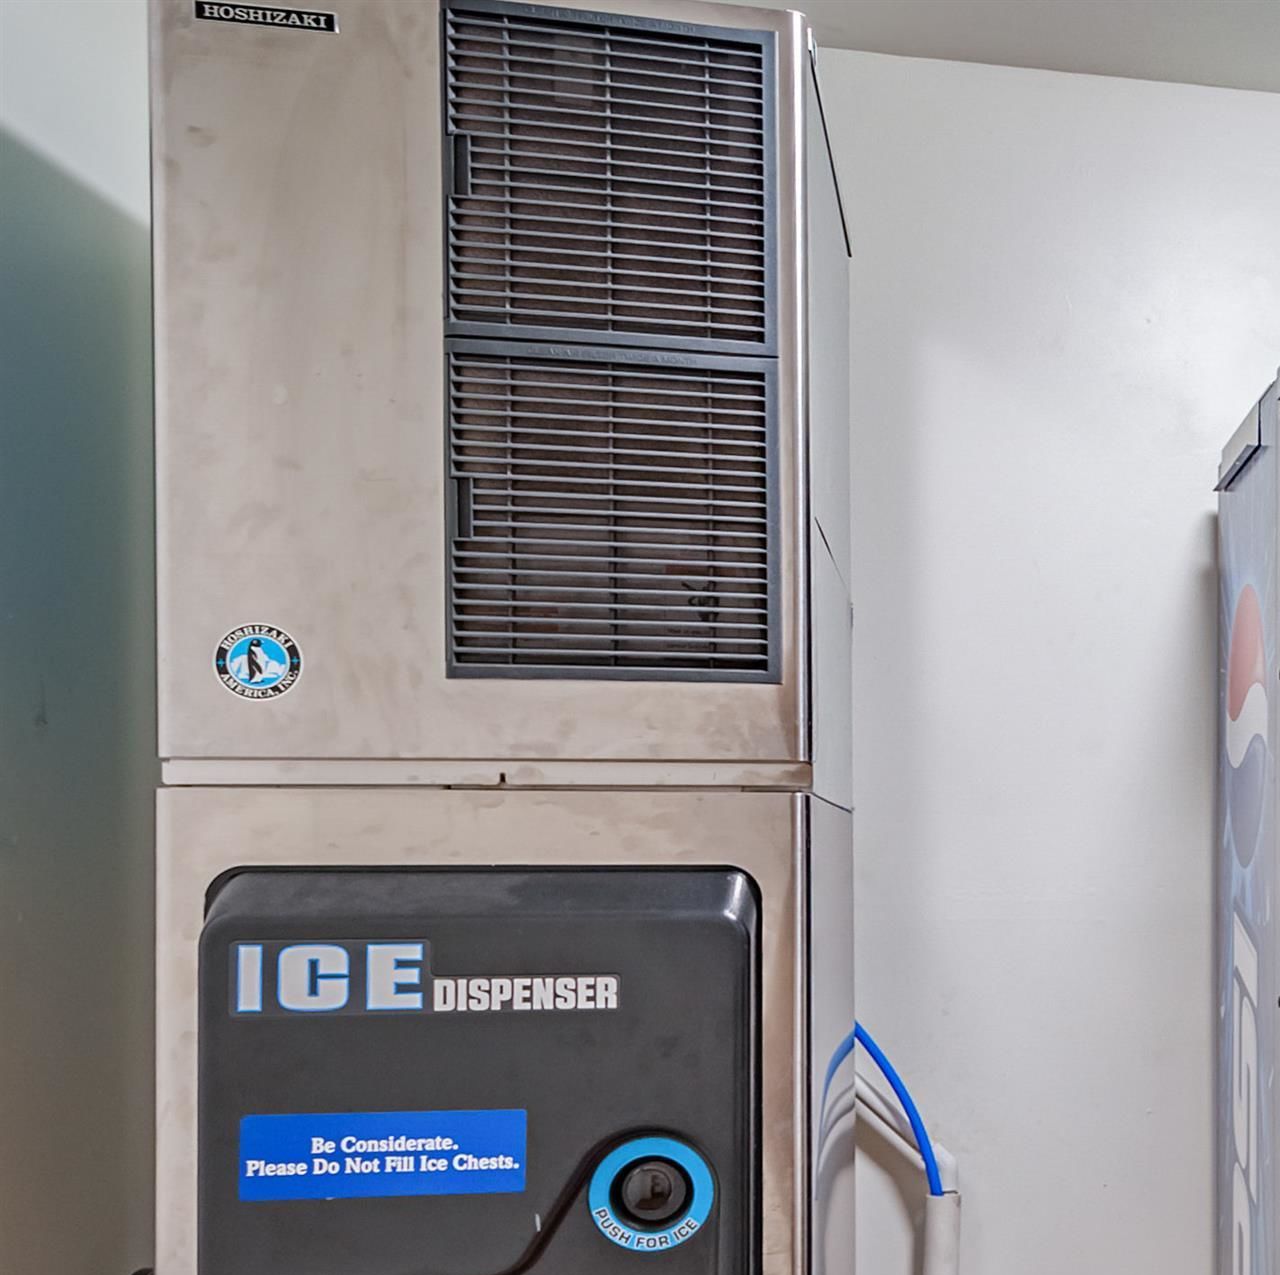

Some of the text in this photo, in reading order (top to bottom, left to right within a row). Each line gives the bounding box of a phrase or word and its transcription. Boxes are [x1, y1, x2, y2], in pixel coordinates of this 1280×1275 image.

[202, 4, 327, 28] HOSHIZAKI
[221, 625, 293, 650] HOSHIZAKI
[236, 944, 619, 1012] ICE DISPENSER
[311, 1135, 459, 1154] Be Considerate.
[246, 1153, 520, 1176] Please Do Not Fill Ice Chests.
[595, 1207, 698, 1249] PUSH FOR ICE
